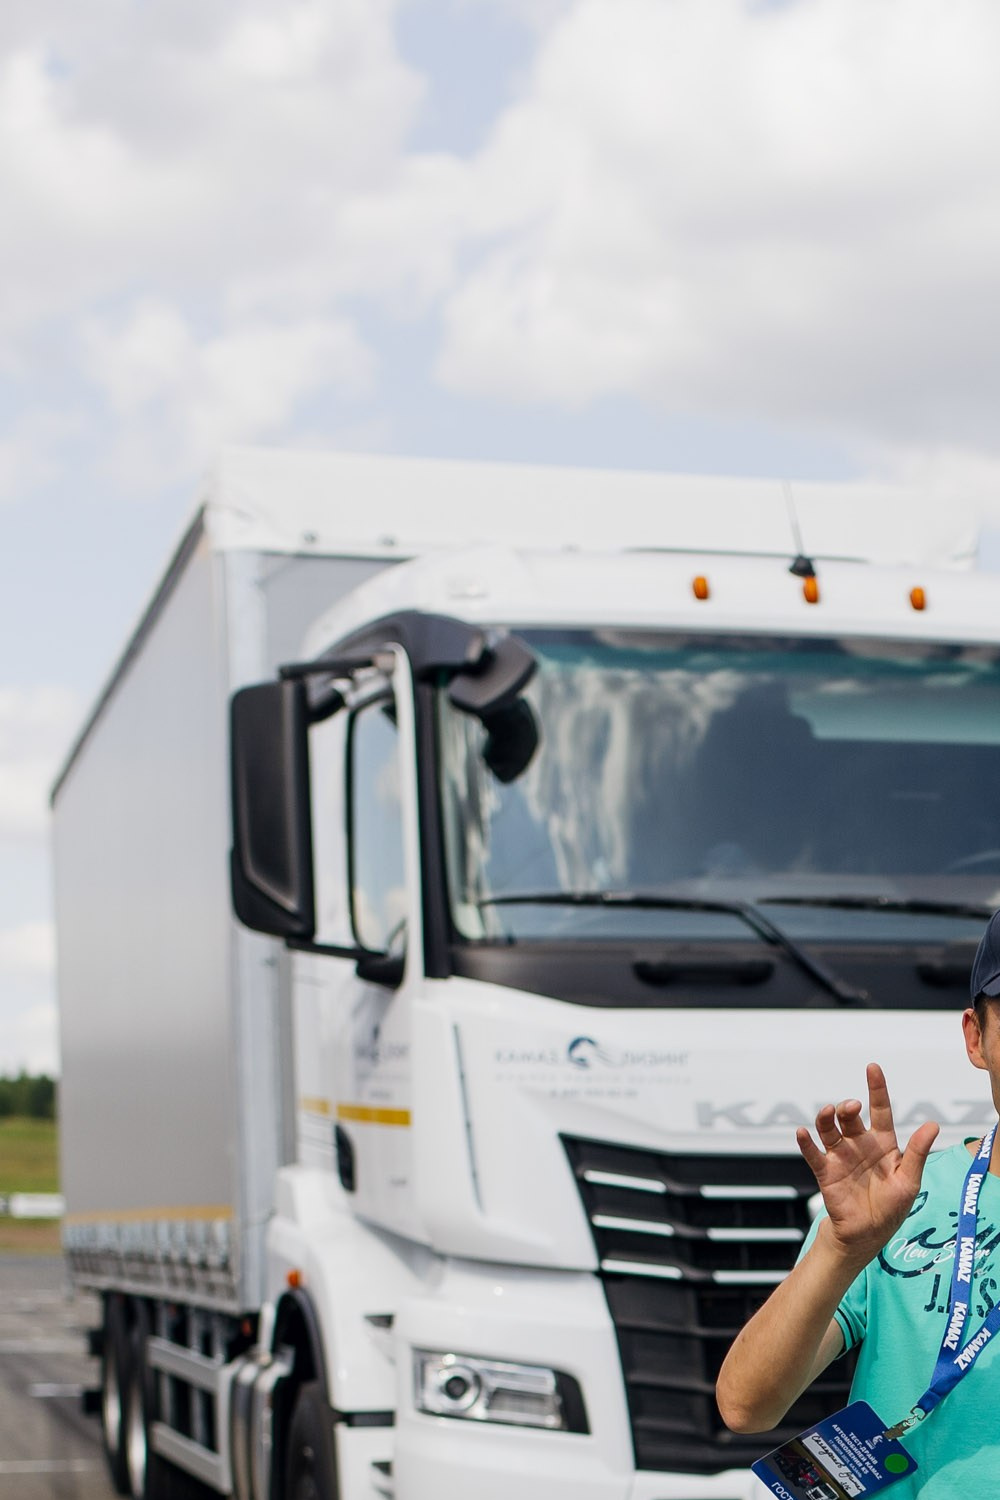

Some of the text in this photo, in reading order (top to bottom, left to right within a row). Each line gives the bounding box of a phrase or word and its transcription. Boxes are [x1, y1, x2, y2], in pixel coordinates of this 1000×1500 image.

[695, 1099, 999, 1128] KAAZ
[963, 1173, 984, 1215] KAMAZ
[957, 1236, 975, 1283] KAMAZ
[943, 1301, 968, 1351] KAMAZ
[954, 1327, 991, 1371] KAMAZ
[832, 1424, 867, 1462] АВТОМОБИЛЕЙ
[865, 1461, 883, 1480] KAMAZ
[834, 1436, 863, 1468] ПОКОЛЕНИЯ
[849, 1432, 878, 1465] ТЕСТ-ДРАЙВ
